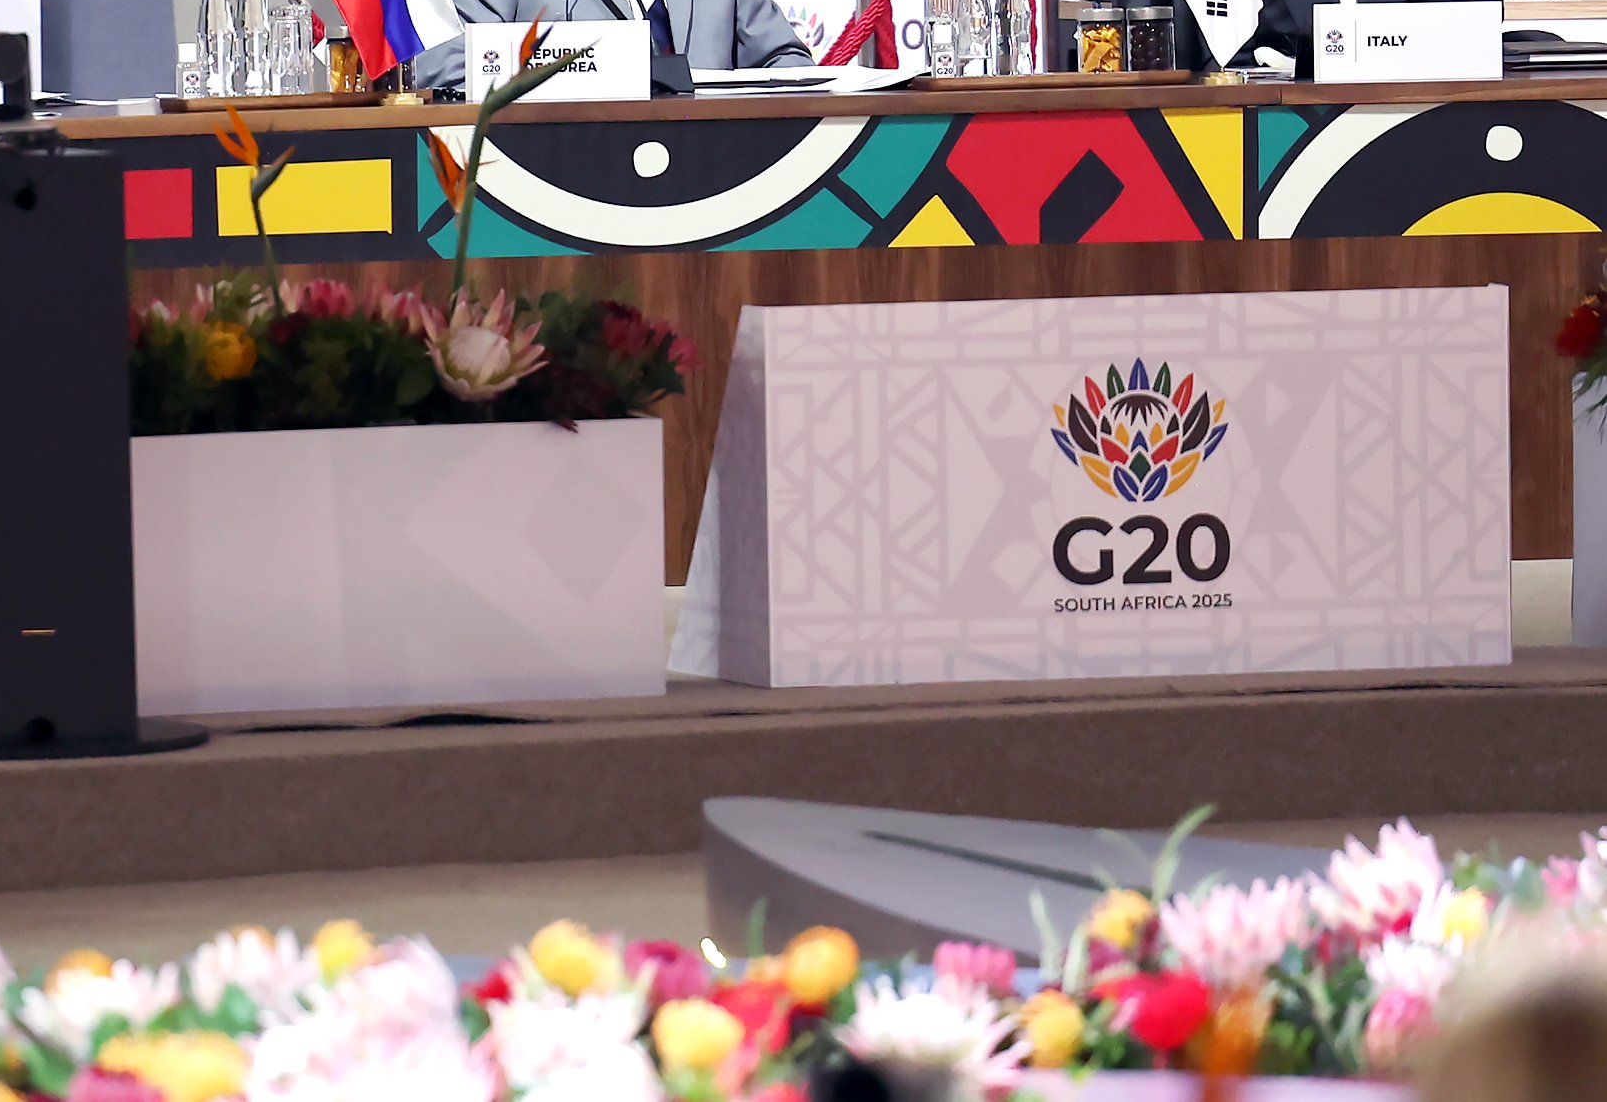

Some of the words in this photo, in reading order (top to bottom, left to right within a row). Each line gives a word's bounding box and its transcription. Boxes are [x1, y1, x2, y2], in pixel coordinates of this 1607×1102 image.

[1367, 35, 1408, 47] ITALY
[527, 48, 595, 60] EPUBLIC
[1325, 44, 1344, 53] G20
[482, 64, 501, 73] G20
[936, 67, 954, 76] G20
[1053, 512, 1231, 585] G20
[1054, 597, 1116, 613] SOUTH
[1121, 595, 1187, 611] AFRICA
[1192, 593, 1233, 609] 2025
